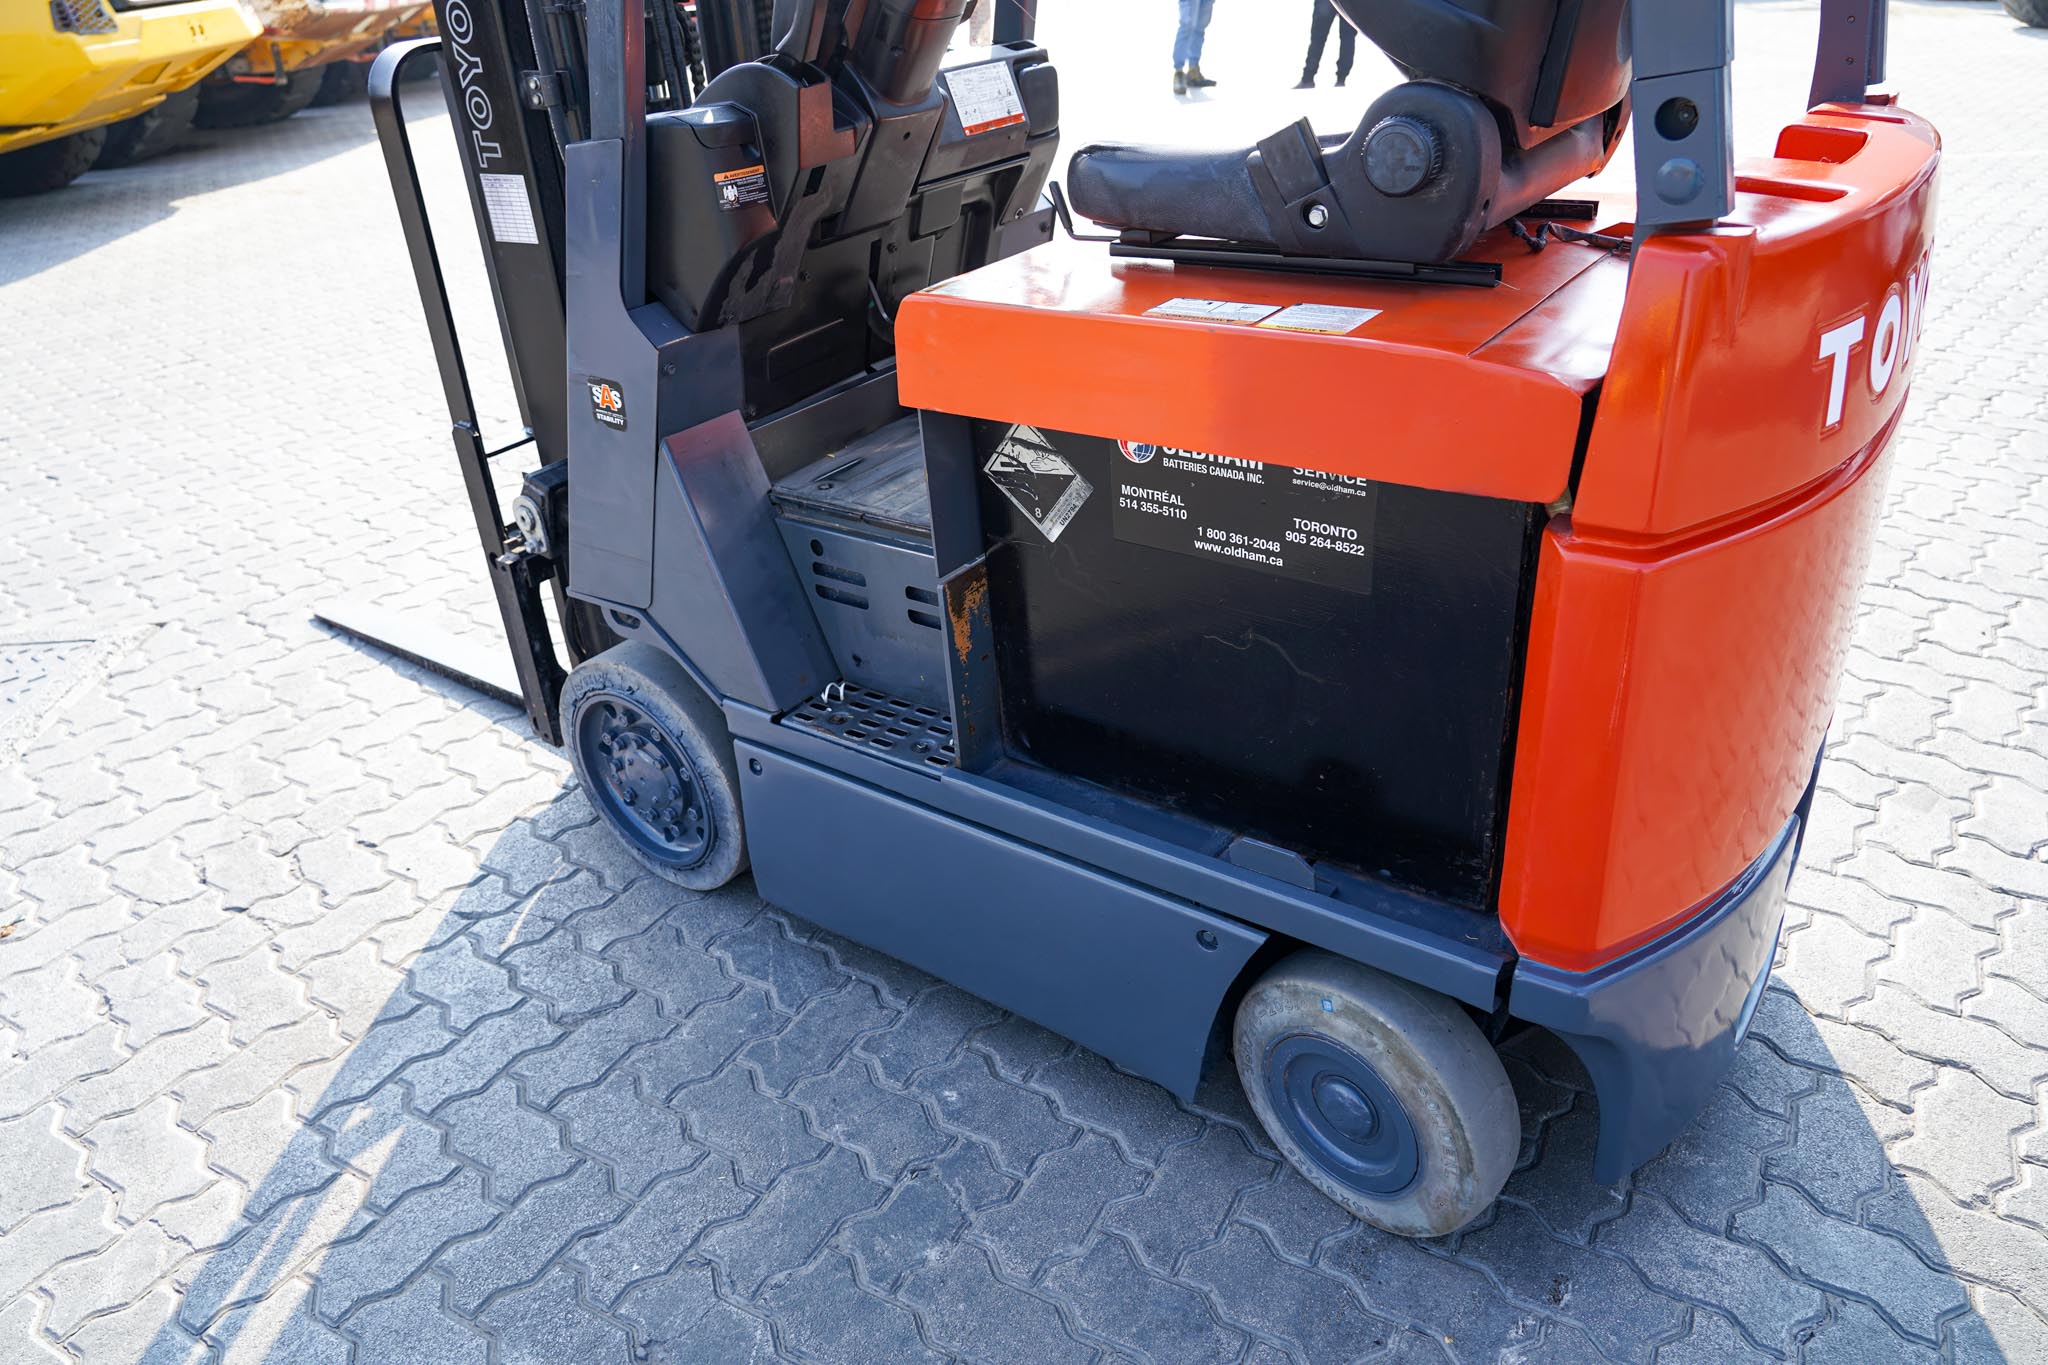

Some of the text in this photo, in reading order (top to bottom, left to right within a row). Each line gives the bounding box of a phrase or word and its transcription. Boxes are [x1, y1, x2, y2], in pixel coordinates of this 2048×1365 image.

[1819, 234, 1935, 427] TOY
[592, 384, 622, 411] SAS
[596, 413, 624, 425] STABILITY
[1163, 458, 1265, 485] BATTERIES CANADA INC.
[1121, 484, 1185, 506] MONTRÉAL
[1292, 478, 1366, 497] service@oldham.ca
[1034, 507, 1042, 518] 8
[1119, 497, 1187, 520] 514 355-5110
[1197, 526, 1281, 553] 1 800 361-2048
[1293, 518, 1357, 540] TORONTO
[1194, 540, 1283, 567] www.oldham.ca
[1285, 531, 1365, 556] 905 264-8522
